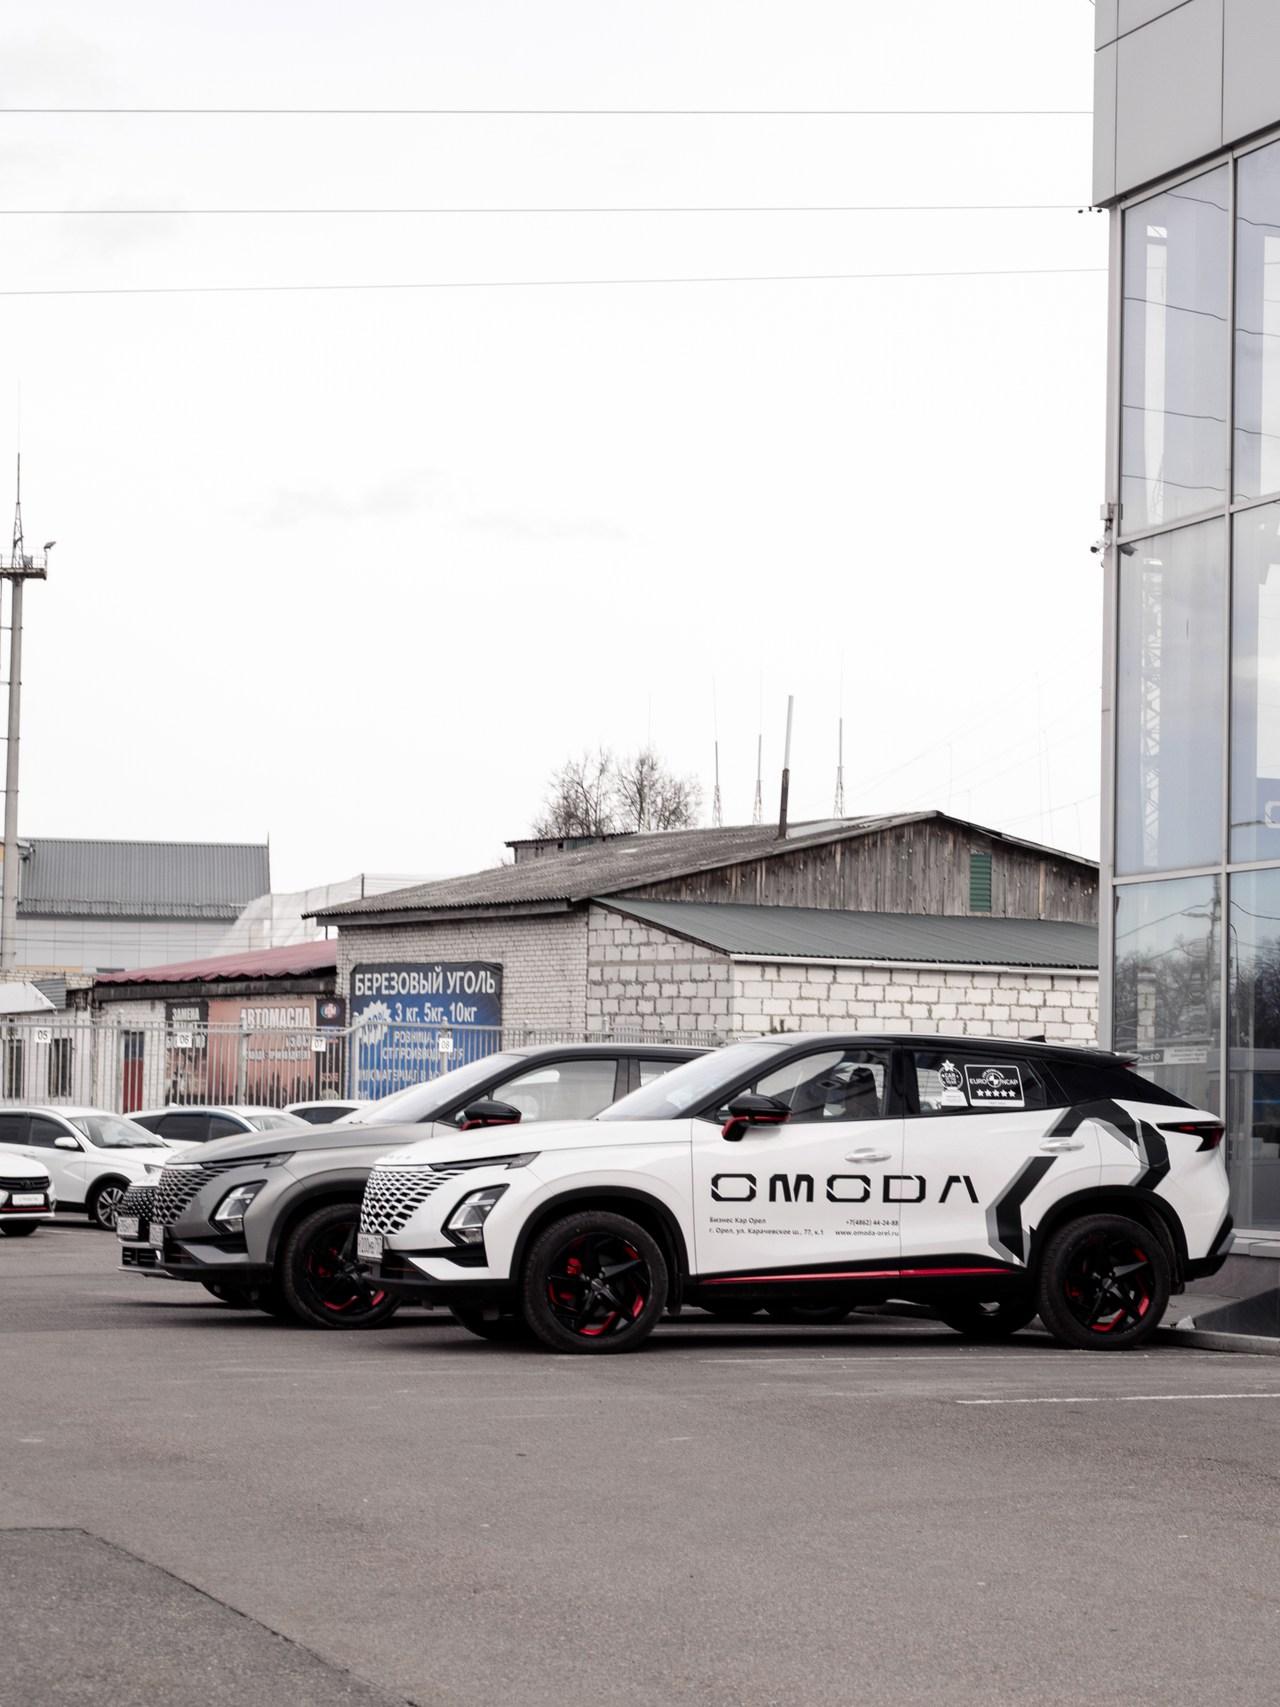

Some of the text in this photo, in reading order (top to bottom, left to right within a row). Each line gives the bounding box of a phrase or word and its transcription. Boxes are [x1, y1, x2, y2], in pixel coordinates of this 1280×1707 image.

[354, 966, 496, 996] БЕРЕЗОВЫЙ УГОЛЬ
[394, 1002, 403, 1023] 3
[449, 1002, 477, 1023] 10кг
[37, 1029, 48, 1040] 05
[179, 1033, 190, 1044] 06
[314, 1037, 323, 1048] 07
[441, 1040, 450, 1050] 08
[711, 1173, 980, 1204] OMODA
[709, 1216, 767, 1225] Бизнес Кар Орел
